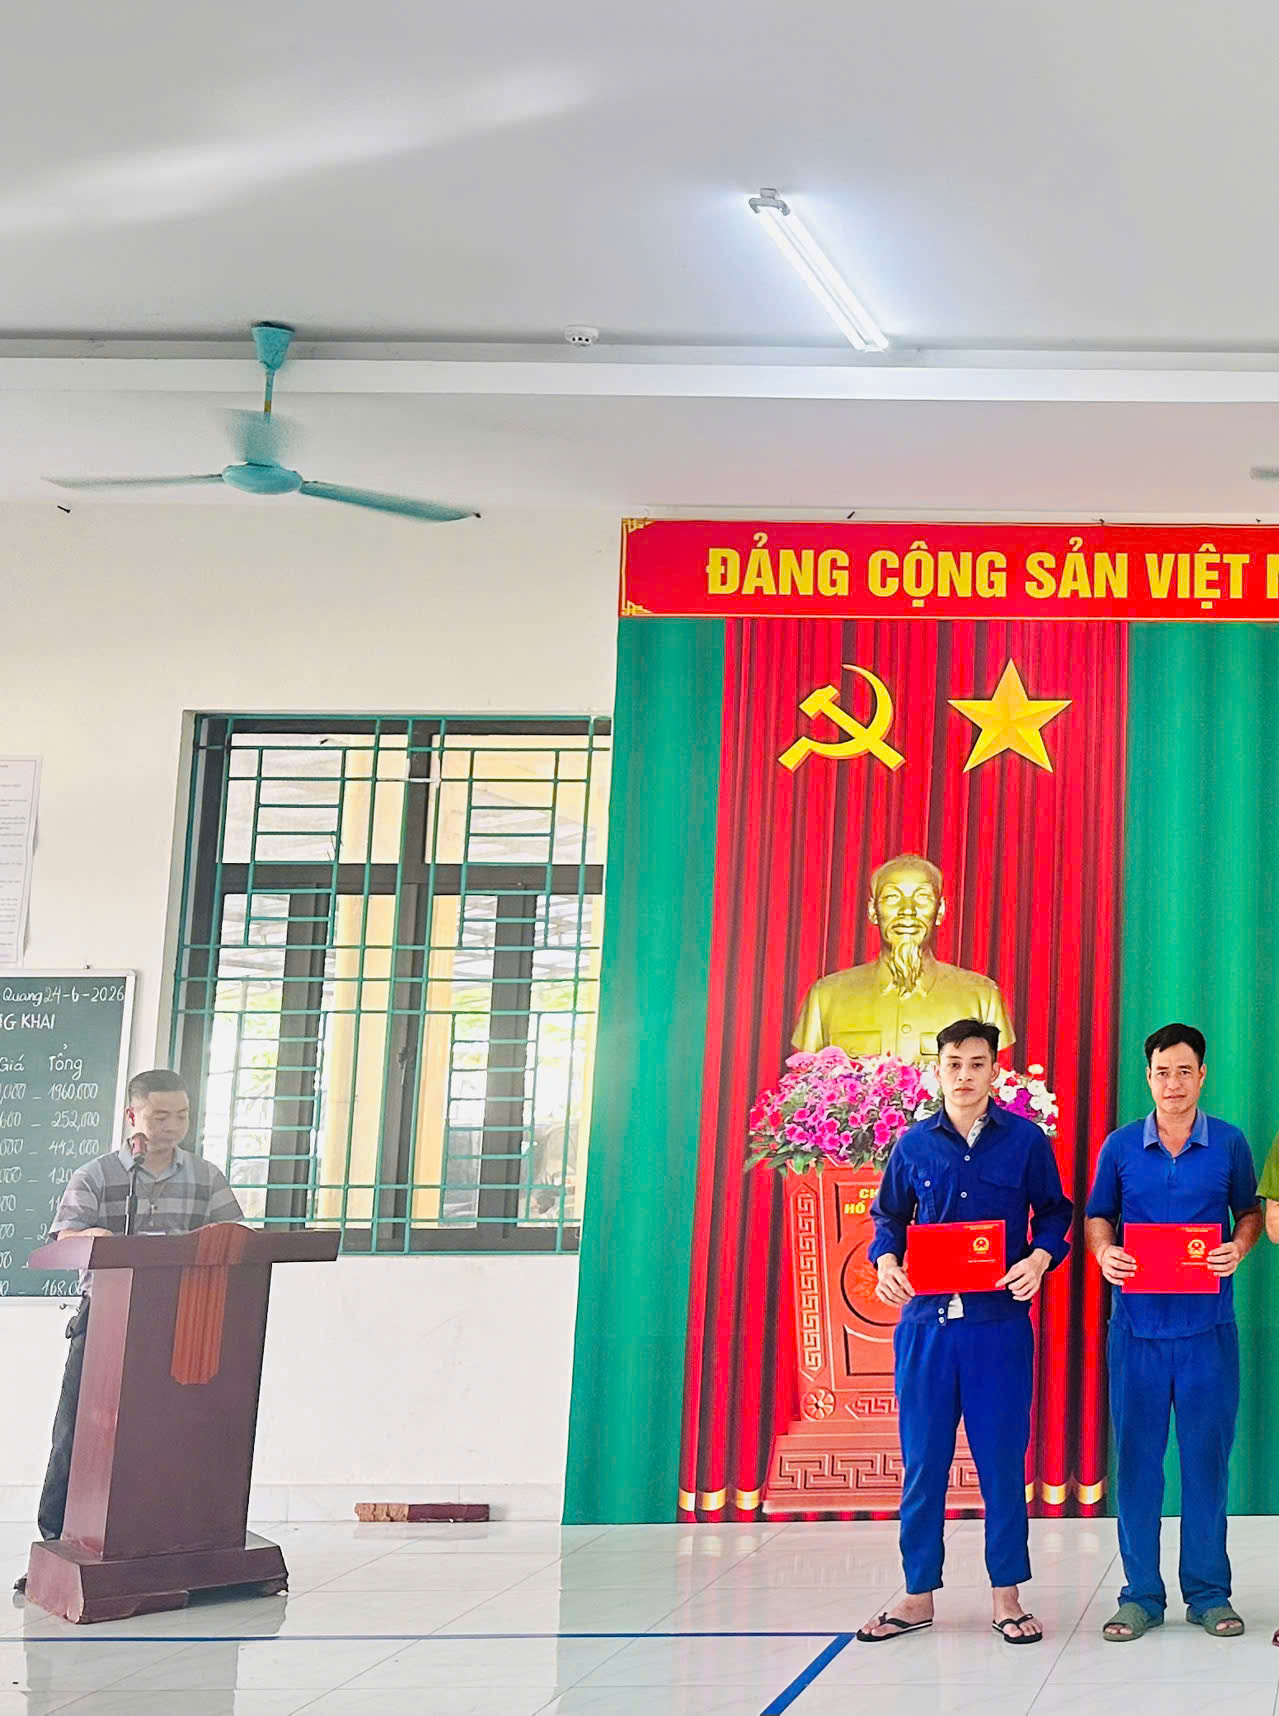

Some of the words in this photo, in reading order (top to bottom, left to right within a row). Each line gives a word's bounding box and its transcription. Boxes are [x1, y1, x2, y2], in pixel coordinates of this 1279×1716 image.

[706, 532, 850, 597] ĐẢNG
[867, 540, 1006, 607] CỘNG
[1025, 537, 1128, 599] SẢN
[1147, 543, 1250, 609] VIỆT
[3, 987, 43, 1007] Quang
[21, 1013, 55, 1030] KHAI
[49, 1043, 83, 1080] Tổng
